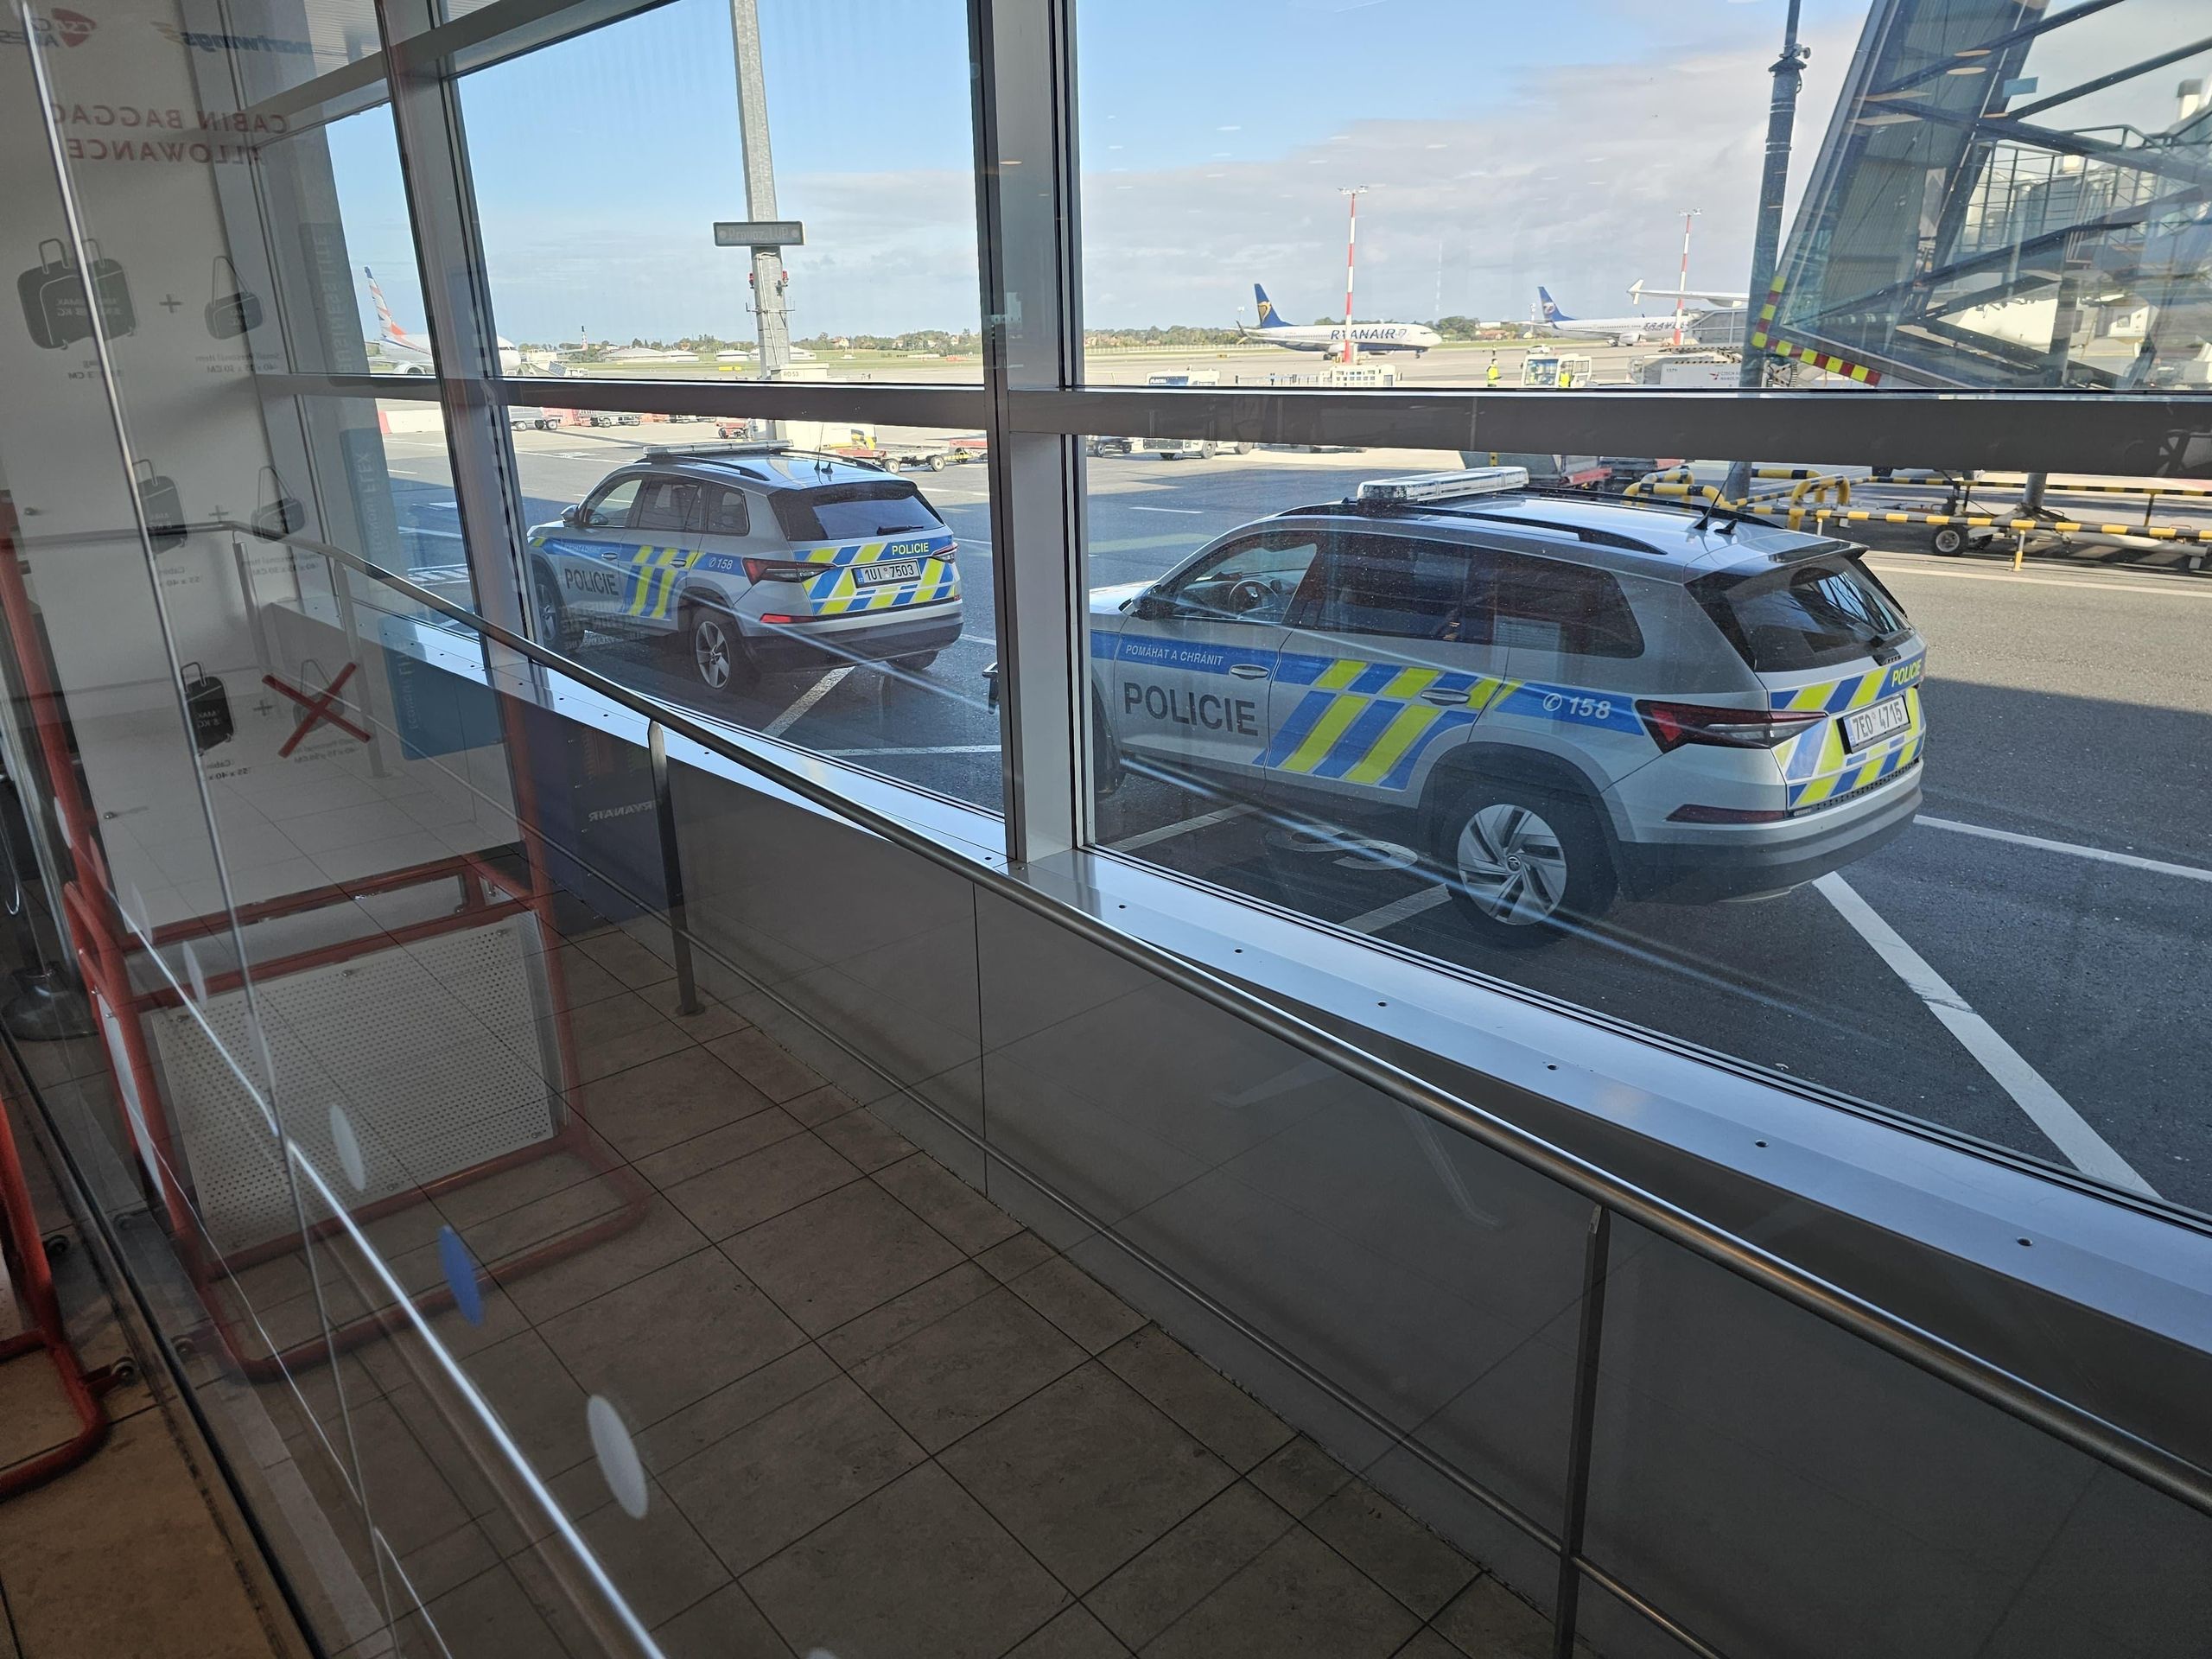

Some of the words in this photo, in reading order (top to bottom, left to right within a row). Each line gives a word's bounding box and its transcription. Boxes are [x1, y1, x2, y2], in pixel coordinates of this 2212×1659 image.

[891, 542, 930, 556] POLICIE
[717, 557, 734, 570] 158
[889, 564, 915, 578] 7503
[564, 568, 620, 596] POLICIE
[1125, 644, 1170, 659] POMÁHAT
[1170, 650, 1178, 661] A
[1179, 651, 1224, 666] CHRÁNIT
[1891, 658, 1923, 688] POLICIE
[1124, 682, 1259, 737] POLICIE
[1569, 696, 1611, 720] 158
[1878, 701, 1903, 729] 4715
